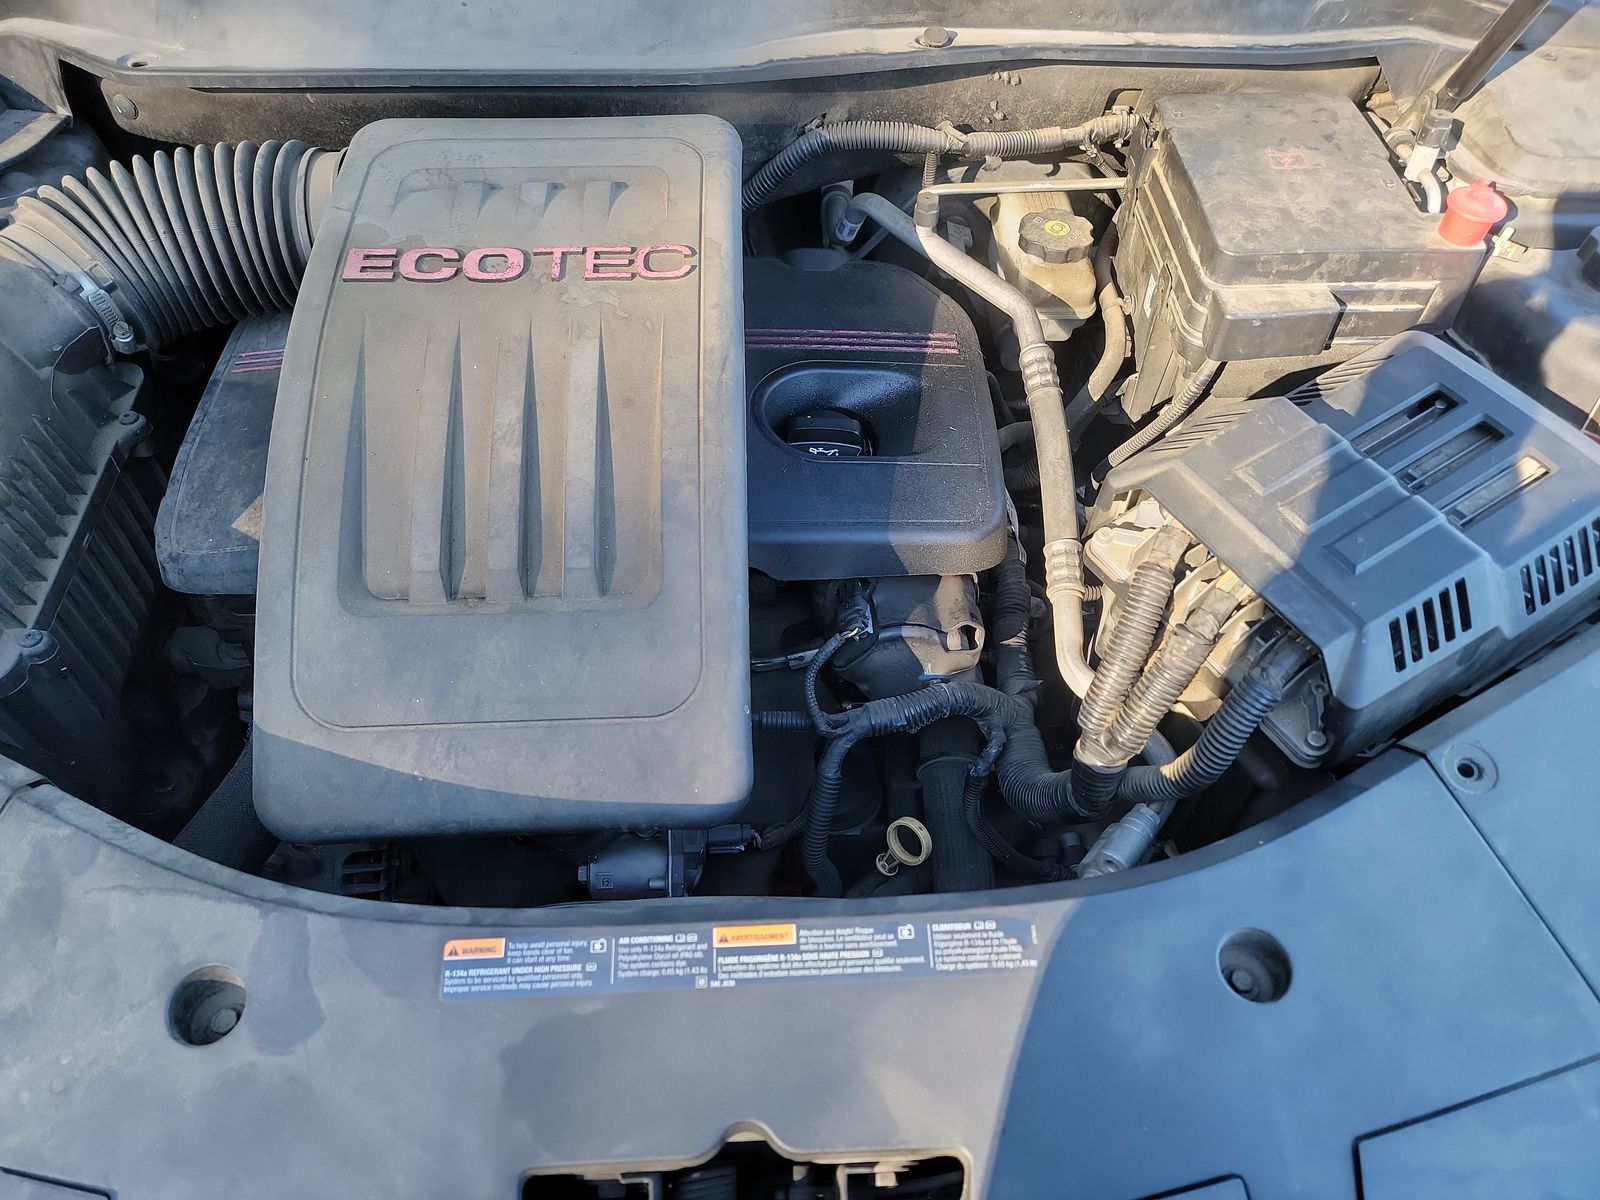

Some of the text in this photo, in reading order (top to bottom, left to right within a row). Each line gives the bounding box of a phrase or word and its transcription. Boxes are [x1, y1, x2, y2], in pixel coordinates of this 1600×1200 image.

[342, 244, 697, 283] ECOTEC
[630, 934, 674, 944] CONDITIONING
[462, 946, 497, 955] WARNING
[445, 963, 582, 978] R-134a REFRIGERANT UNDER HIGH PRESSURE
